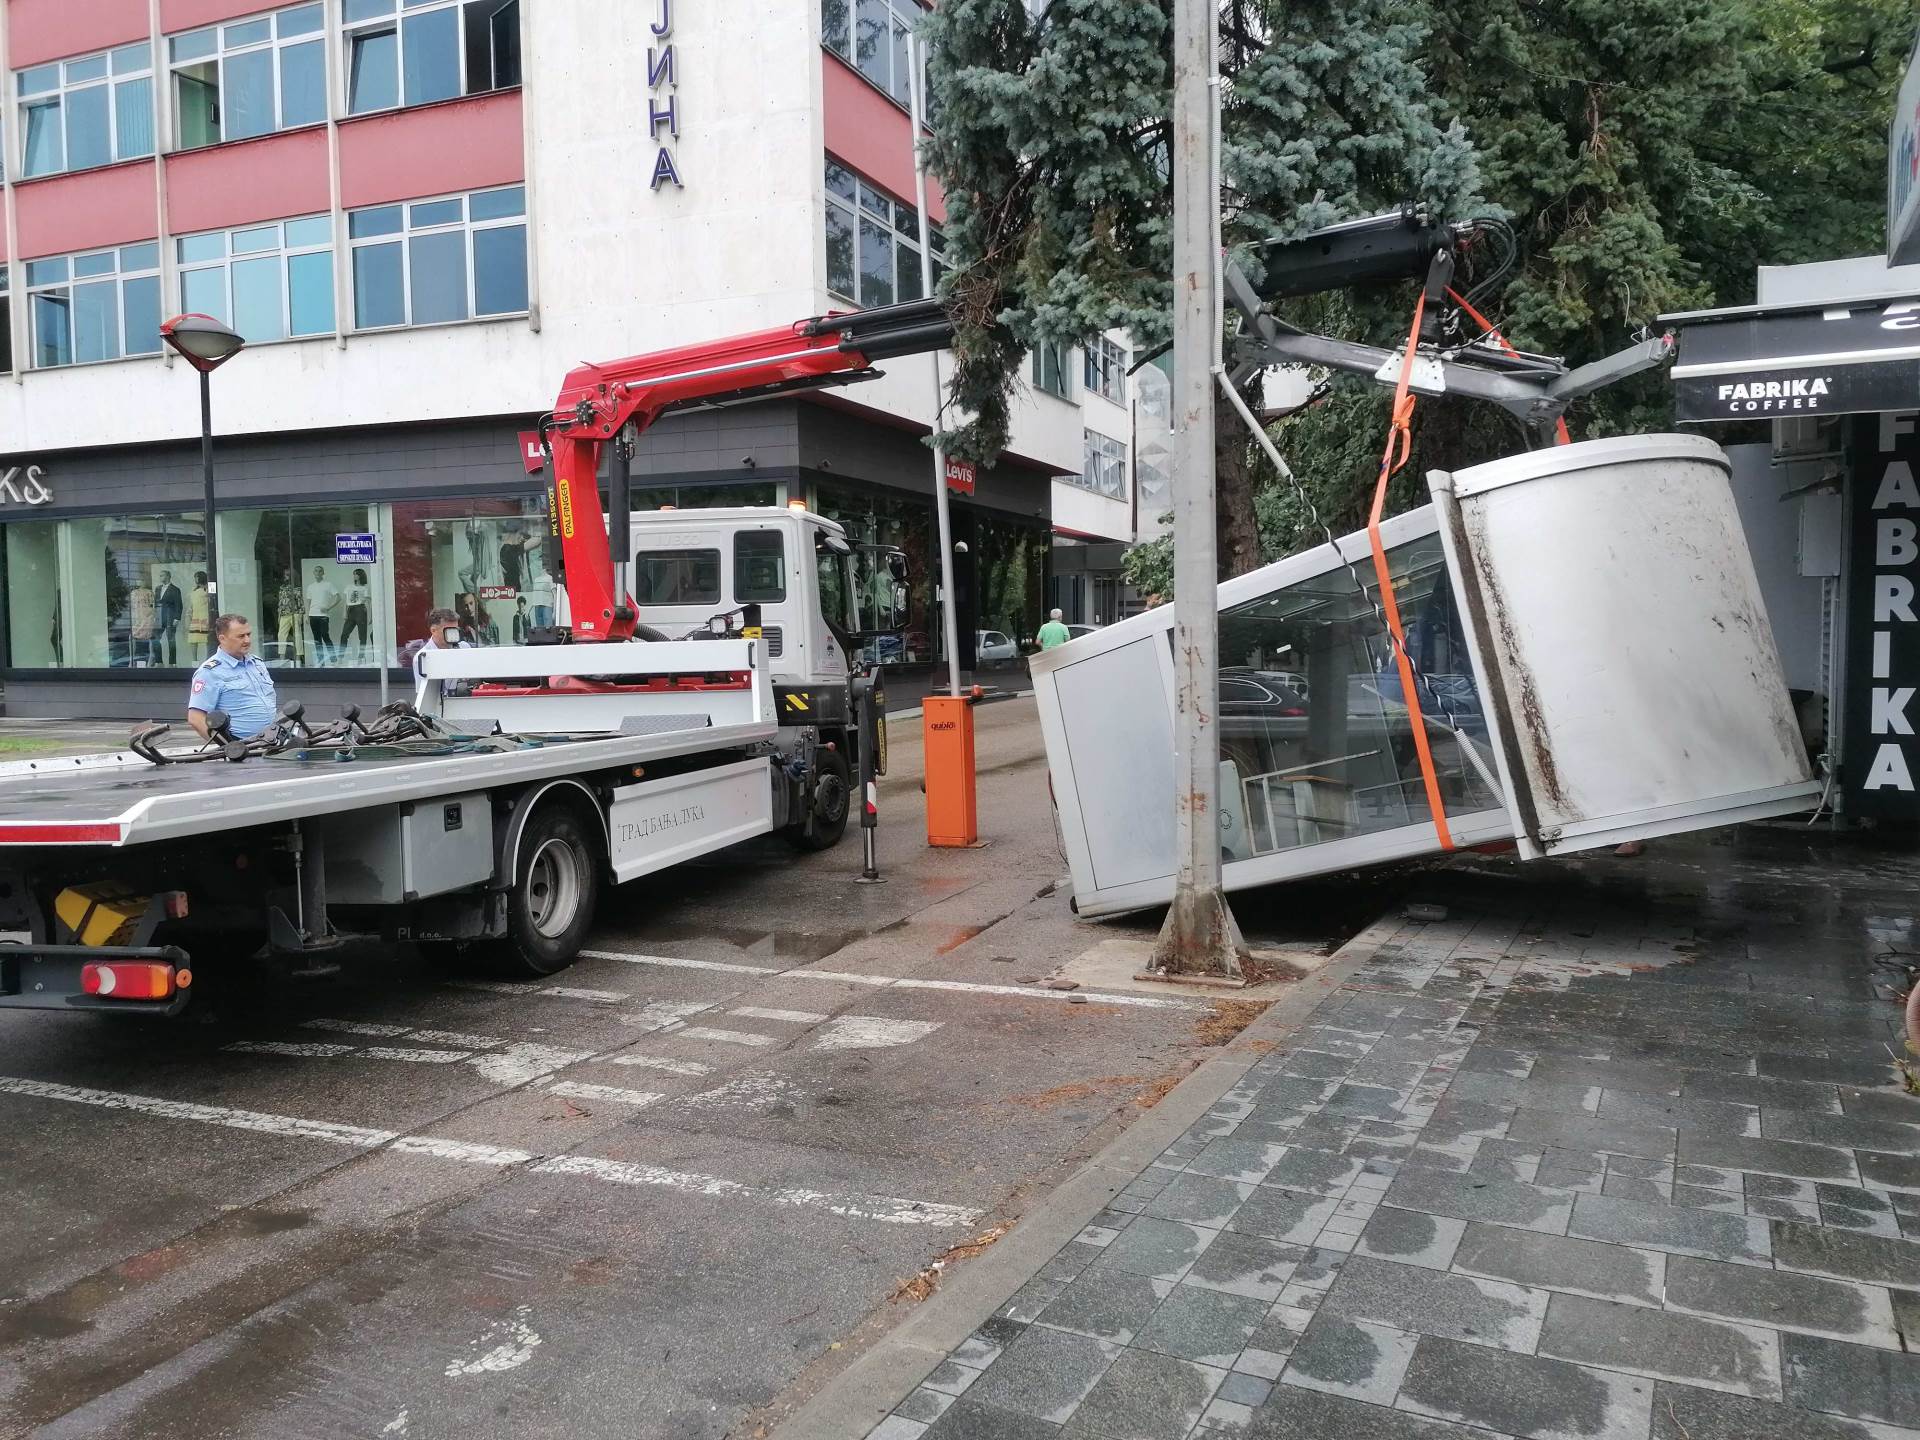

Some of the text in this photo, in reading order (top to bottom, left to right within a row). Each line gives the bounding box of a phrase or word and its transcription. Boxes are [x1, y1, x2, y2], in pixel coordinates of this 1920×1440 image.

[1718, 377, 1829, 400] FABRIKA
[1729, 397, 1818, 412] COFFEE
[560, 482, 573, 535] PALFINGER
[1863, 409, 1920, 791] FABRIKA
